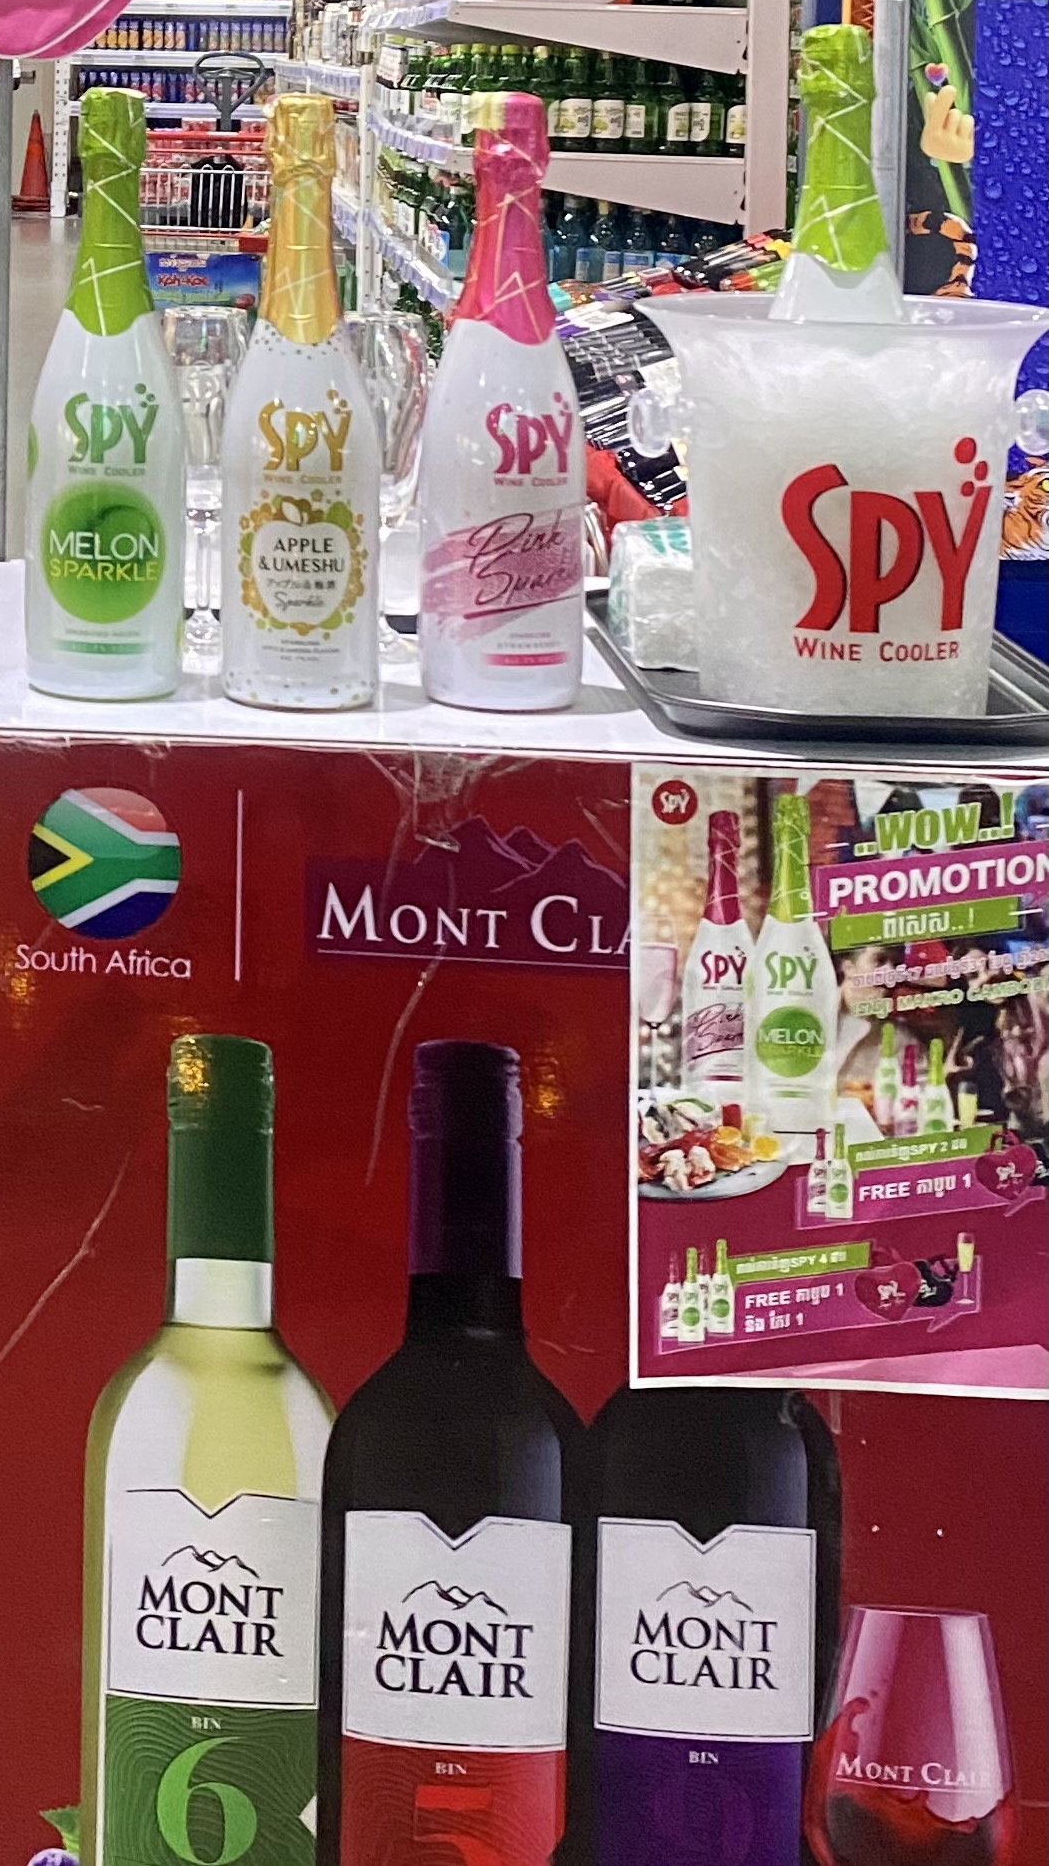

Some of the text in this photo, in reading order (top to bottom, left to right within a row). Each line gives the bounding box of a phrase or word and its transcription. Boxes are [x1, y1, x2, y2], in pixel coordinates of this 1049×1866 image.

[64, 383, 160, 464] SPY
[258, 389, 353, 471] SPY
[485, 391, 573, 475] SPY
[50, 529, 159, 561] MELON
[273, 537, 334, 553] APPLE
[463, 509, 566, 575] Pink
[782, 436, 993, 634] SPY
[50, 558, 158, 582] SPARKLE
[273, 557, 345, 573] UMESHU
[794, 636, 959, 664] WINE COOLER
[661, 788, 691, 814] SPY
[828, 852, 1049, 908] PROMOTION
[316, 882, 508, 951] MONT
[14, 944, 192, 980] South Africa
[700, 946, 747, 985] SPY
[764, 946, 818, 989] SPY
[757, 1028, 825, 1045] MELON
[940, 1143, 948, 1152] 2
[859, 1182, 911, 1202] FREE
[962, 1173, 972, 1189] 1
[818, 1254, 828, 1265] 4
[745, 1290, 791, 1309] FREE
[836, 1283, 844, 1296] 1
[796, 1311, 804, 1326] 1
[138, 1575, 284, 1621] MONT
[136, 1614, 284, 1658] CLAIR
[376, 1610, 534, 1659] MONT
[631, 1609, 779, 1653] MONT
[375, 1654, 534, 1699] CLAIR
[630, 1648, 779, 1691] CLAIR
[191, 1716, 223, 1731] BIN
[435, 1761, 468, 1776] BIN
[688, 1750, 719, 1765] BIN
[836, 1753, 914, 1784] MONT
[157, 1736, 257, 1866] 6
